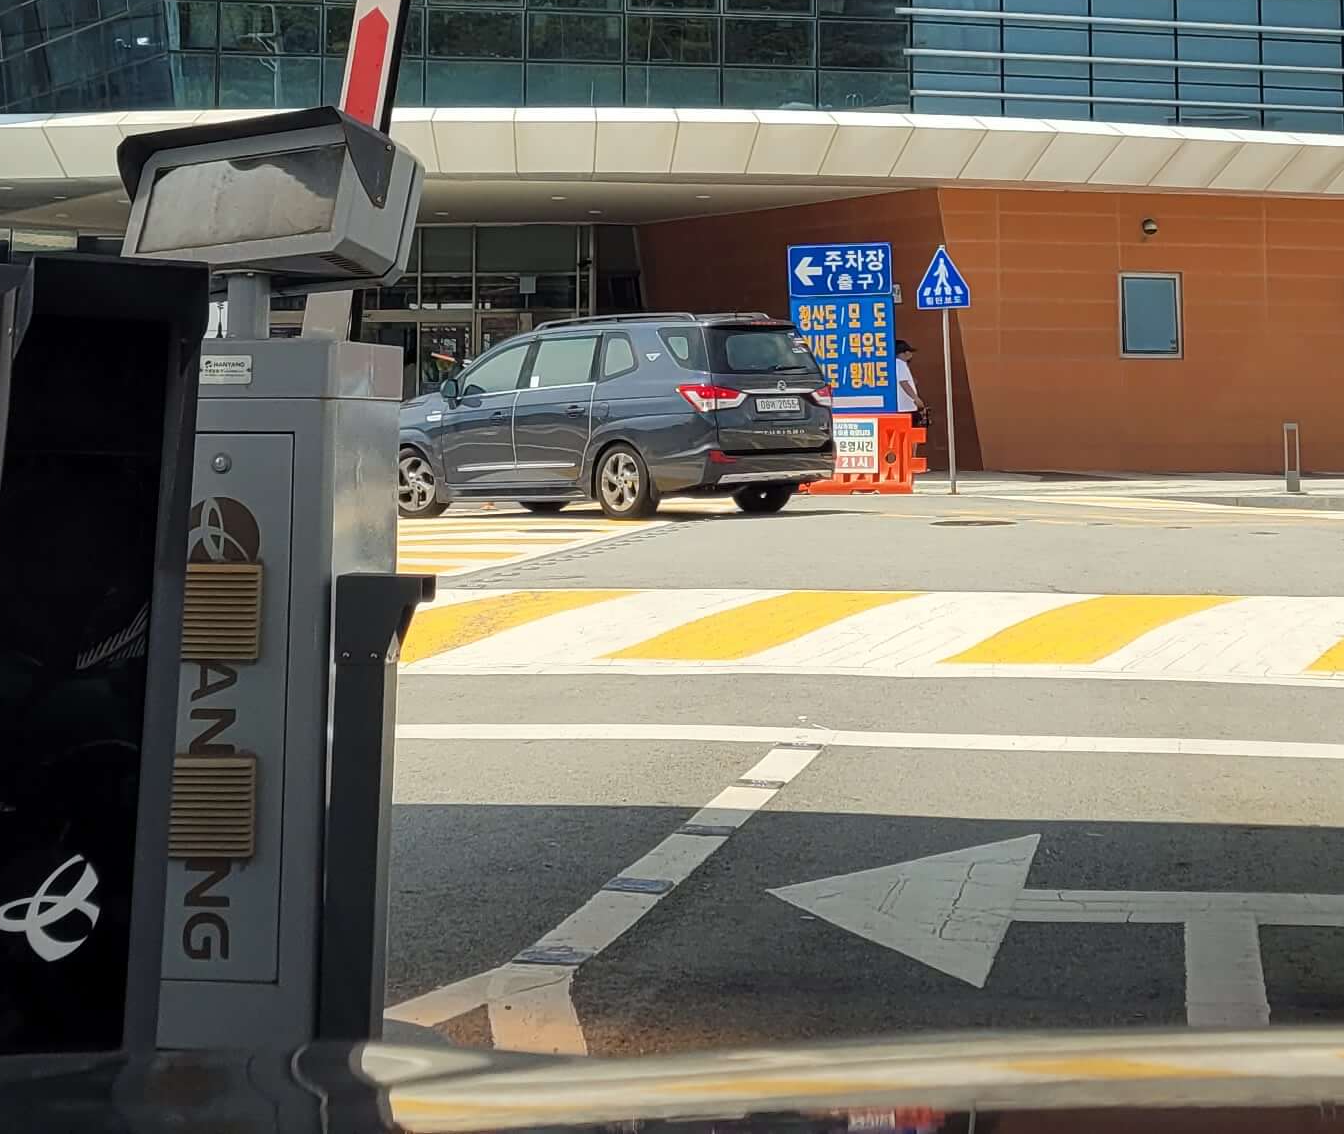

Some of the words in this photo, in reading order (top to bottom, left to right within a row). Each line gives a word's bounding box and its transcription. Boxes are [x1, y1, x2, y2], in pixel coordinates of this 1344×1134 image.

[824, 249, 885, 272] 주차장
[826, 272, 884, 292] (출구)
[839, 440, 874, 453] 운영시간
